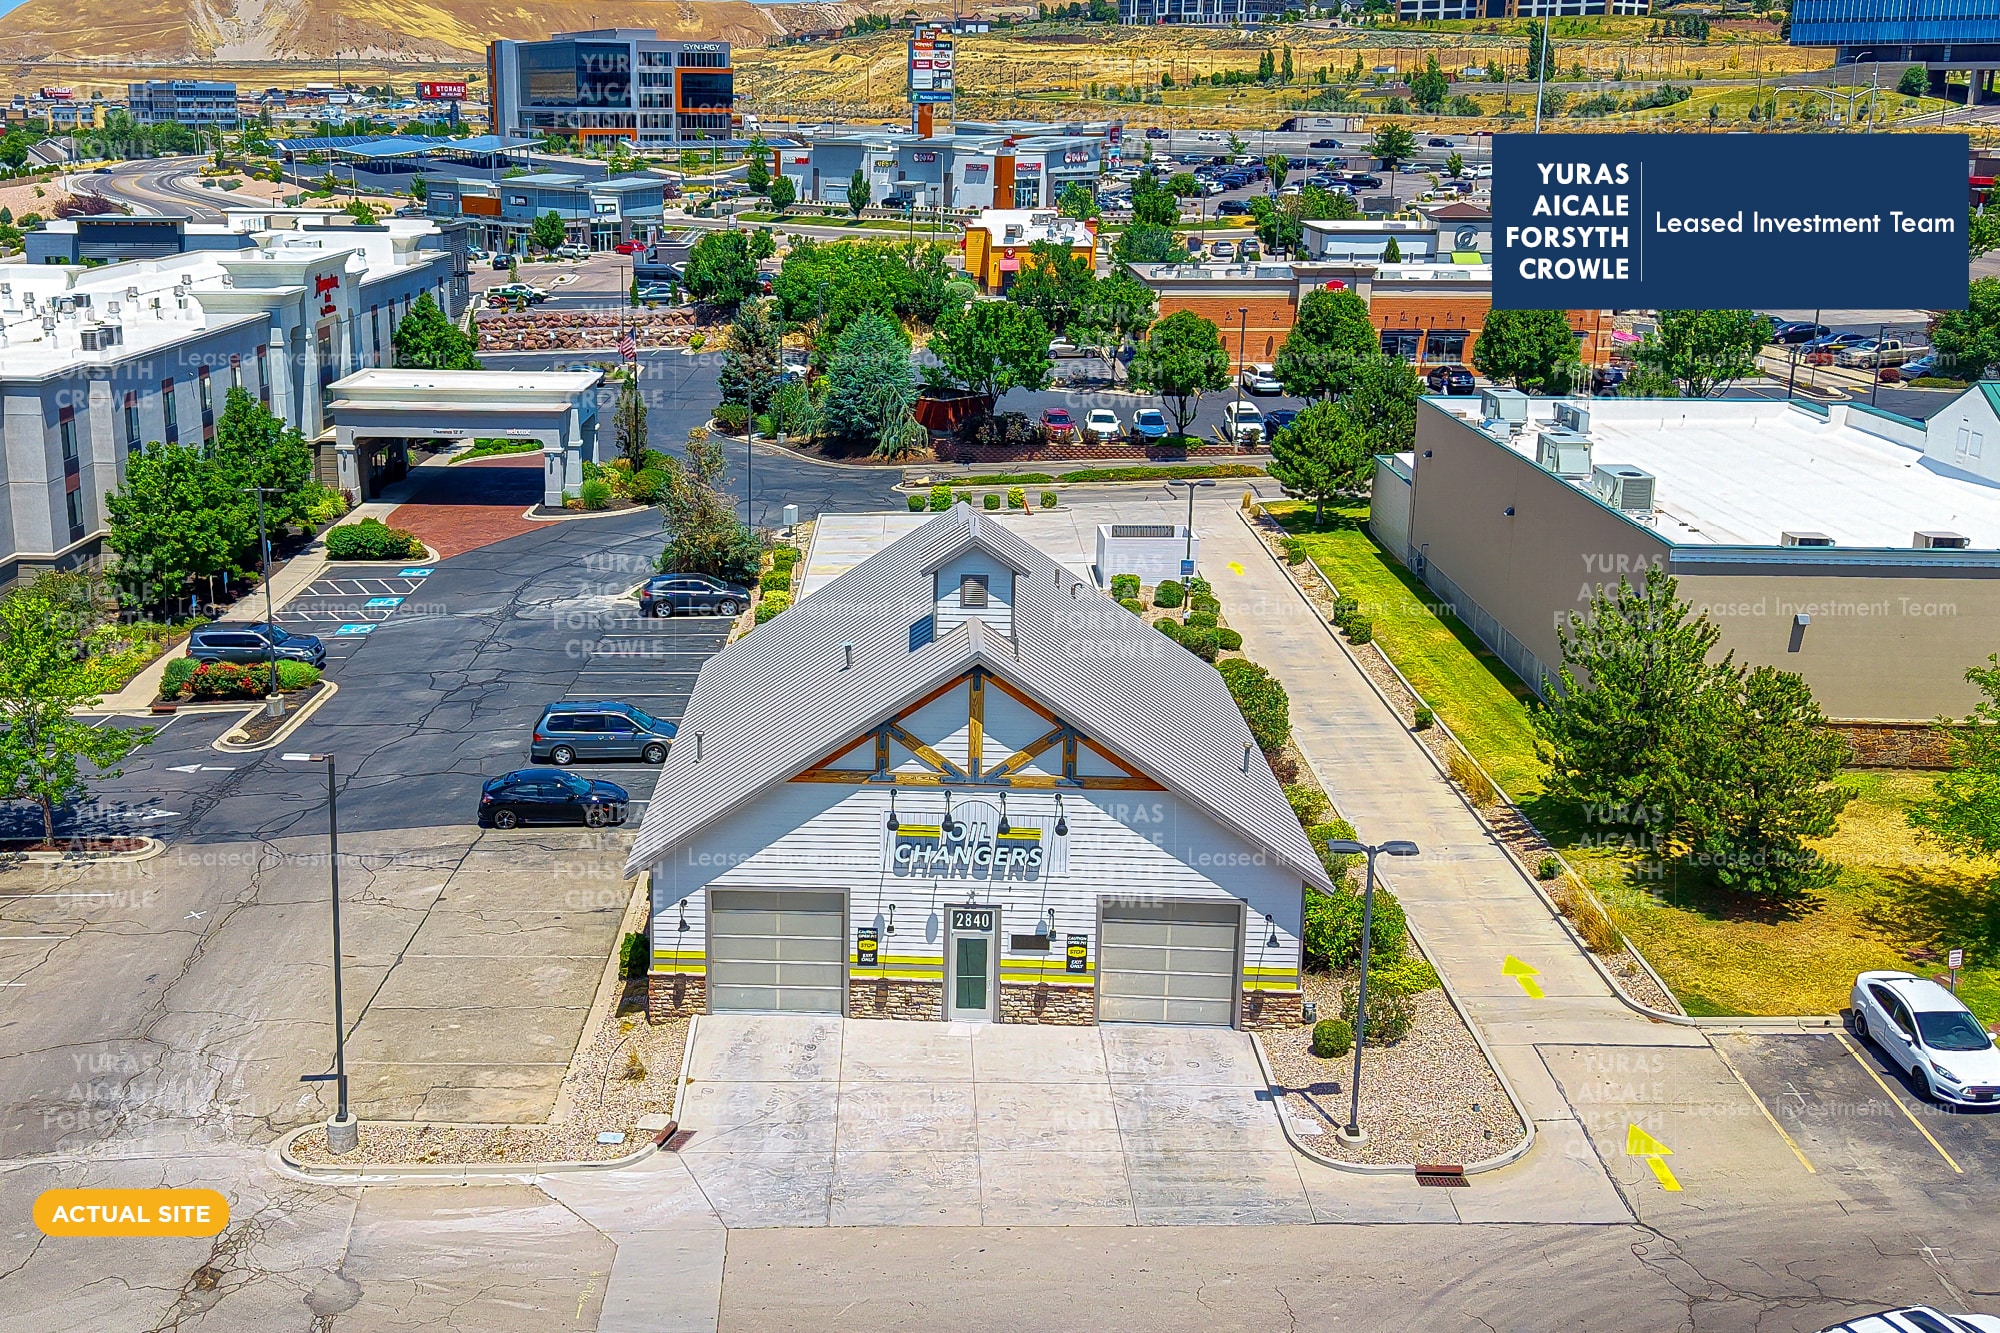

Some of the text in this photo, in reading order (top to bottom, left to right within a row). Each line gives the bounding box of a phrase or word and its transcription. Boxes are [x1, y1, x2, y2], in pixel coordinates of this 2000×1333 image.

[435, 85, 466, 93] STORAGE
[947, 821, 992, 843] OIL
[895, 842, 1043, 867] CHANGERS
[956, 912, 990, 928] 2840
